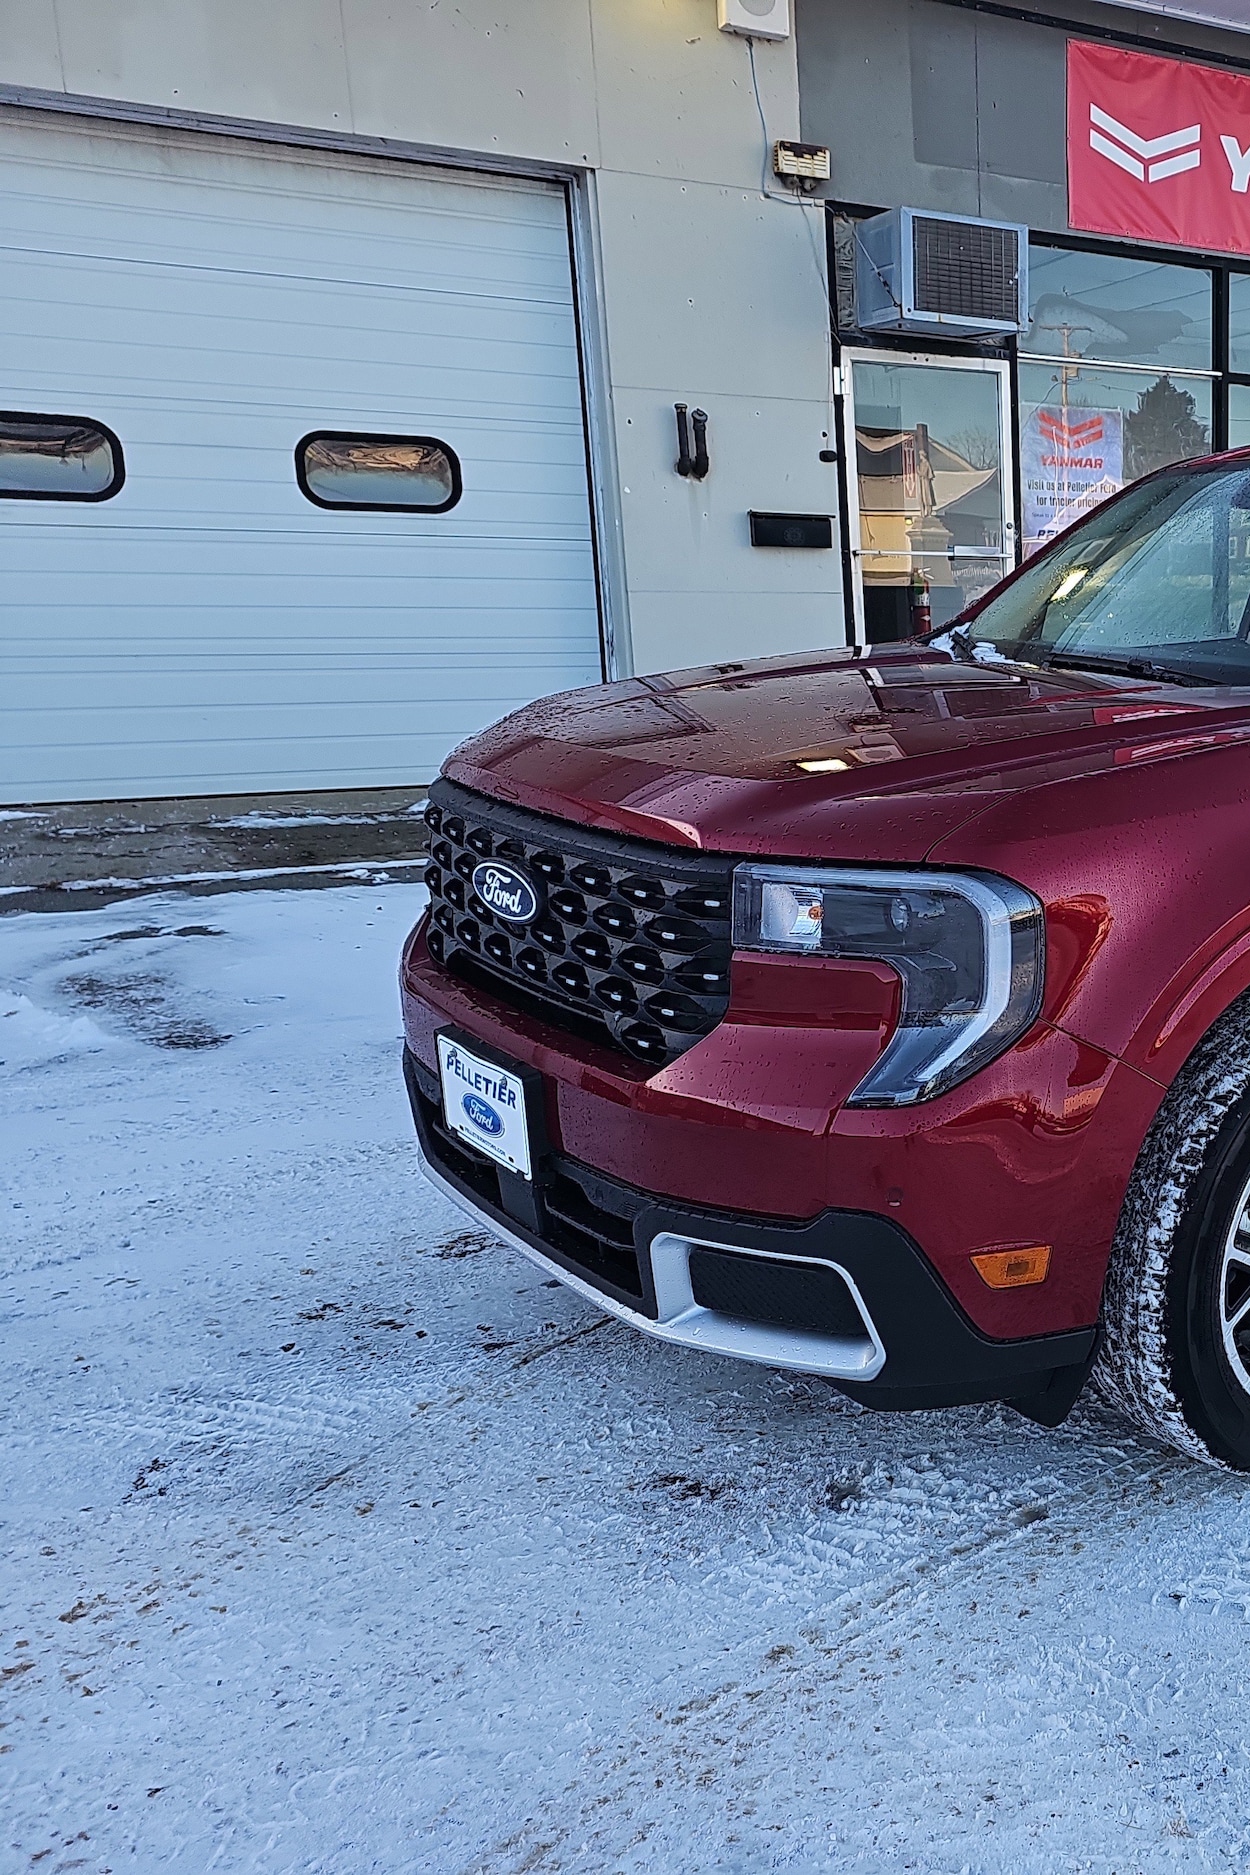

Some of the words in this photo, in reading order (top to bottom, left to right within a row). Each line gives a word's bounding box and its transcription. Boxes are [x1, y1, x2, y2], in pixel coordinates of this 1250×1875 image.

[1041, 454, 1104, 469] YANMAR
[1027, 479, 1044, 491] Visit
[1046, 481, 1055, 491] us
[1057, 481, 1065, 491] at
[1036, 495, 1048, 506] for
[483, 868, 522, 914] Ford
[446, 1053, 517, 1110] PELLETIER
[469, 1099, 494, 1131] Ford
